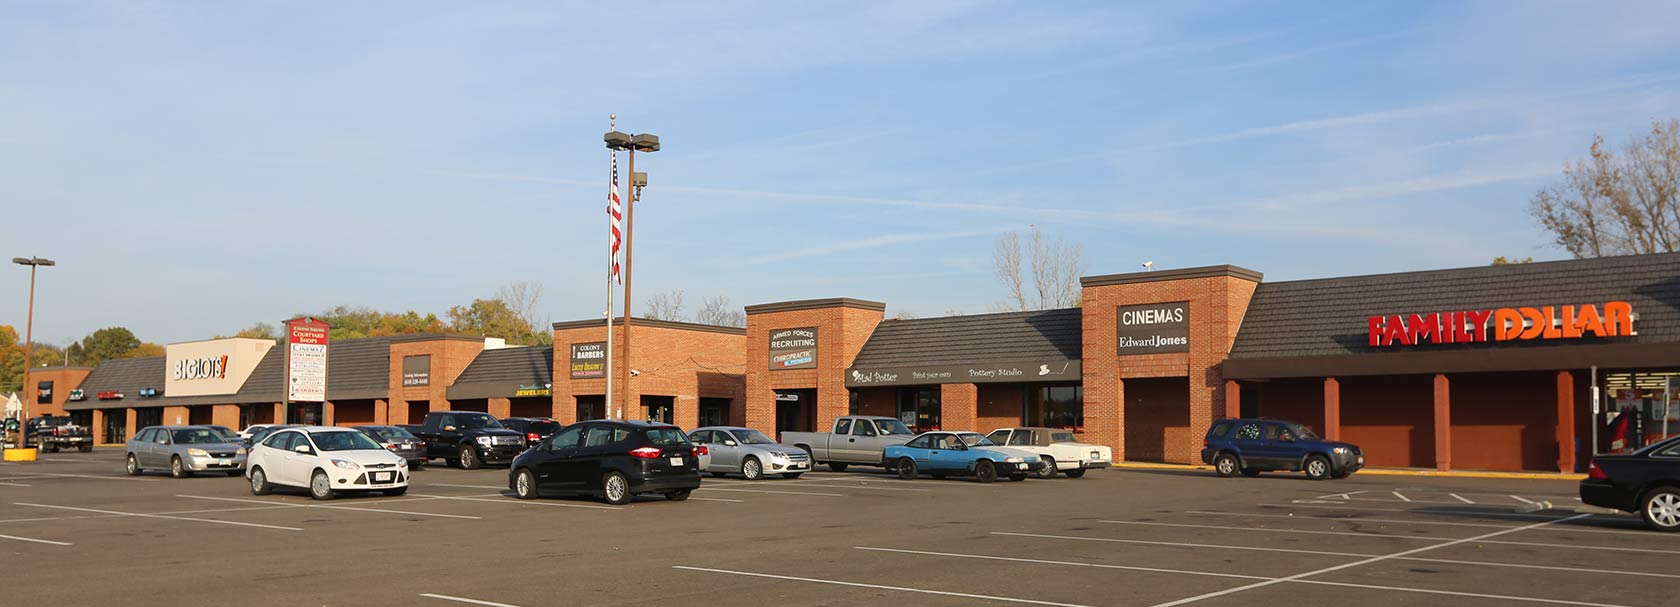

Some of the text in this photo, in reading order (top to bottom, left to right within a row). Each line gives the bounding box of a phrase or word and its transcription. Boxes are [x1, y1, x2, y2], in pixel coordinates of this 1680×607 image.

[1122, 307, 1183, 325] CINEMAS
[1368, 301, 1633, 346] FAMILY DOLLAR
[772, 330, 814, 340] ARMED FORCES
[771, 338, 815, 348] RECRUITING
[1119, 335, 1187, 347] Edward Jones
[577, 350, 604, 359] BARBERS
[874, 371, 897, 382] Potter
[969, 367, 1023, 378] Pottery Studio
[515, 389, 550, 397] JEWELERS
